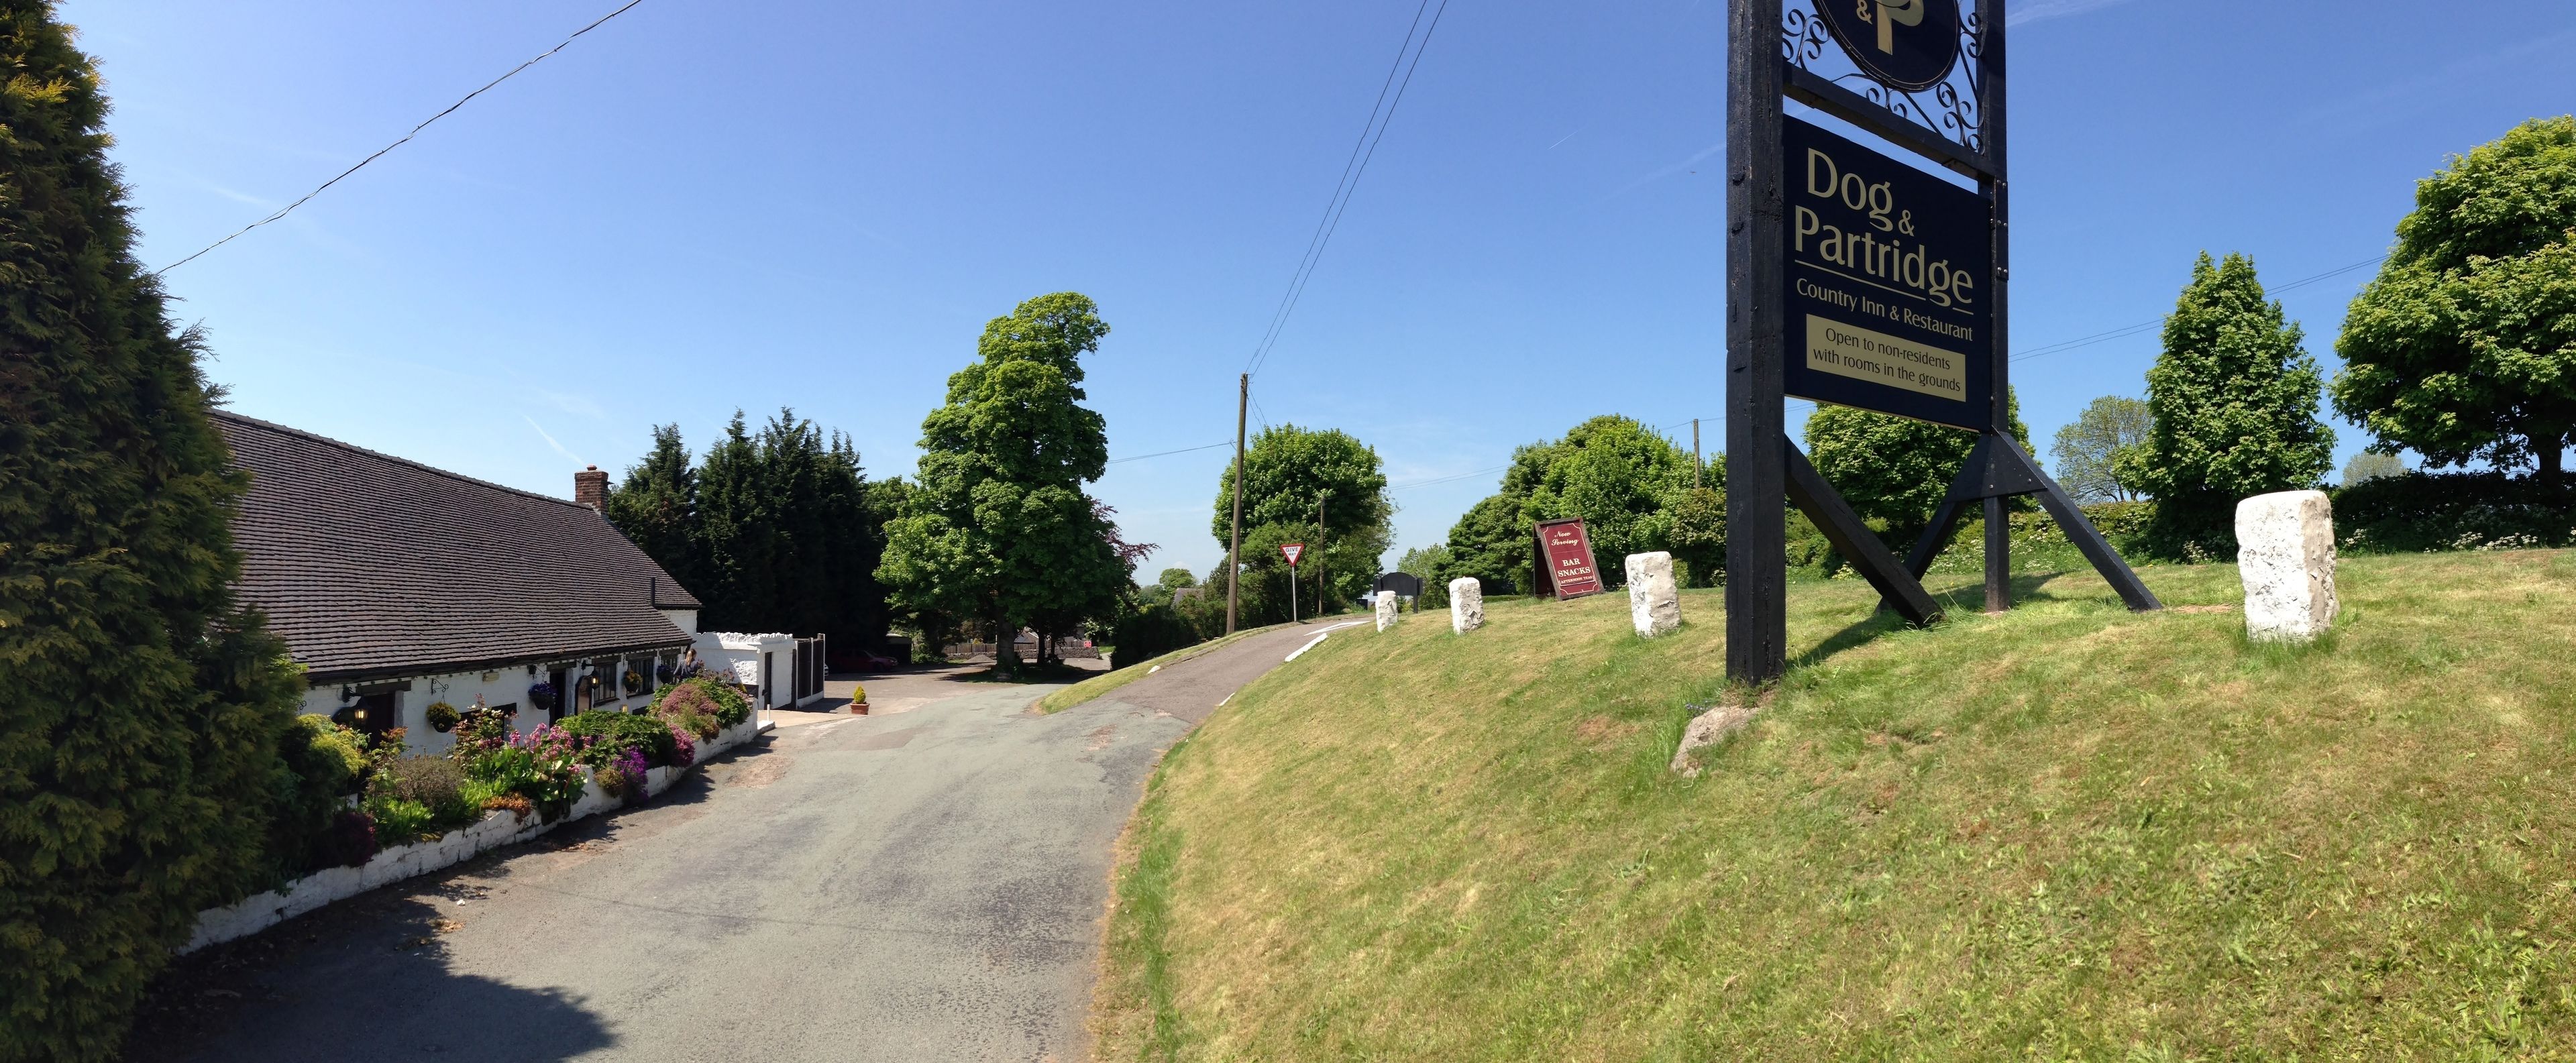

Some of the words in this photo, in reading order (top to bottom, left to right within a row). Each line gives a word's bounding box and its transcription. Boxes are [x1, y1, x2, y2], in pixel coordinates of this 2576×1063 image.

[1856, 0, 1873, 24] &
[1808, 147, 1893, 231] Dog
[1898, 209, 1915, 237] &
[1795, 205, 1974, 306] Partridge
[1796, 278, 1858, 312] Country
[1862, 296, 1885, 317] Inn
[1889, 305, 1899, 321] &
[1904, 307, 1973, 341] Restaurant
[1813, 348, 1839, 365] with
[1843, 354, 1880, 374] rooms
[1884, 363, 1894, 377] in
[1898, 366, 1915, 382] the
[1919, 372, 1961, 392] grounds
[1825, 327, 1859, 347] Open
[1862, 337, 1874, 351] to
[1878, 343, 1951, 370] non-residents
[1557, 566, 1591, 577] SNACKS
[1562, 558, 1580, 566] BAR
